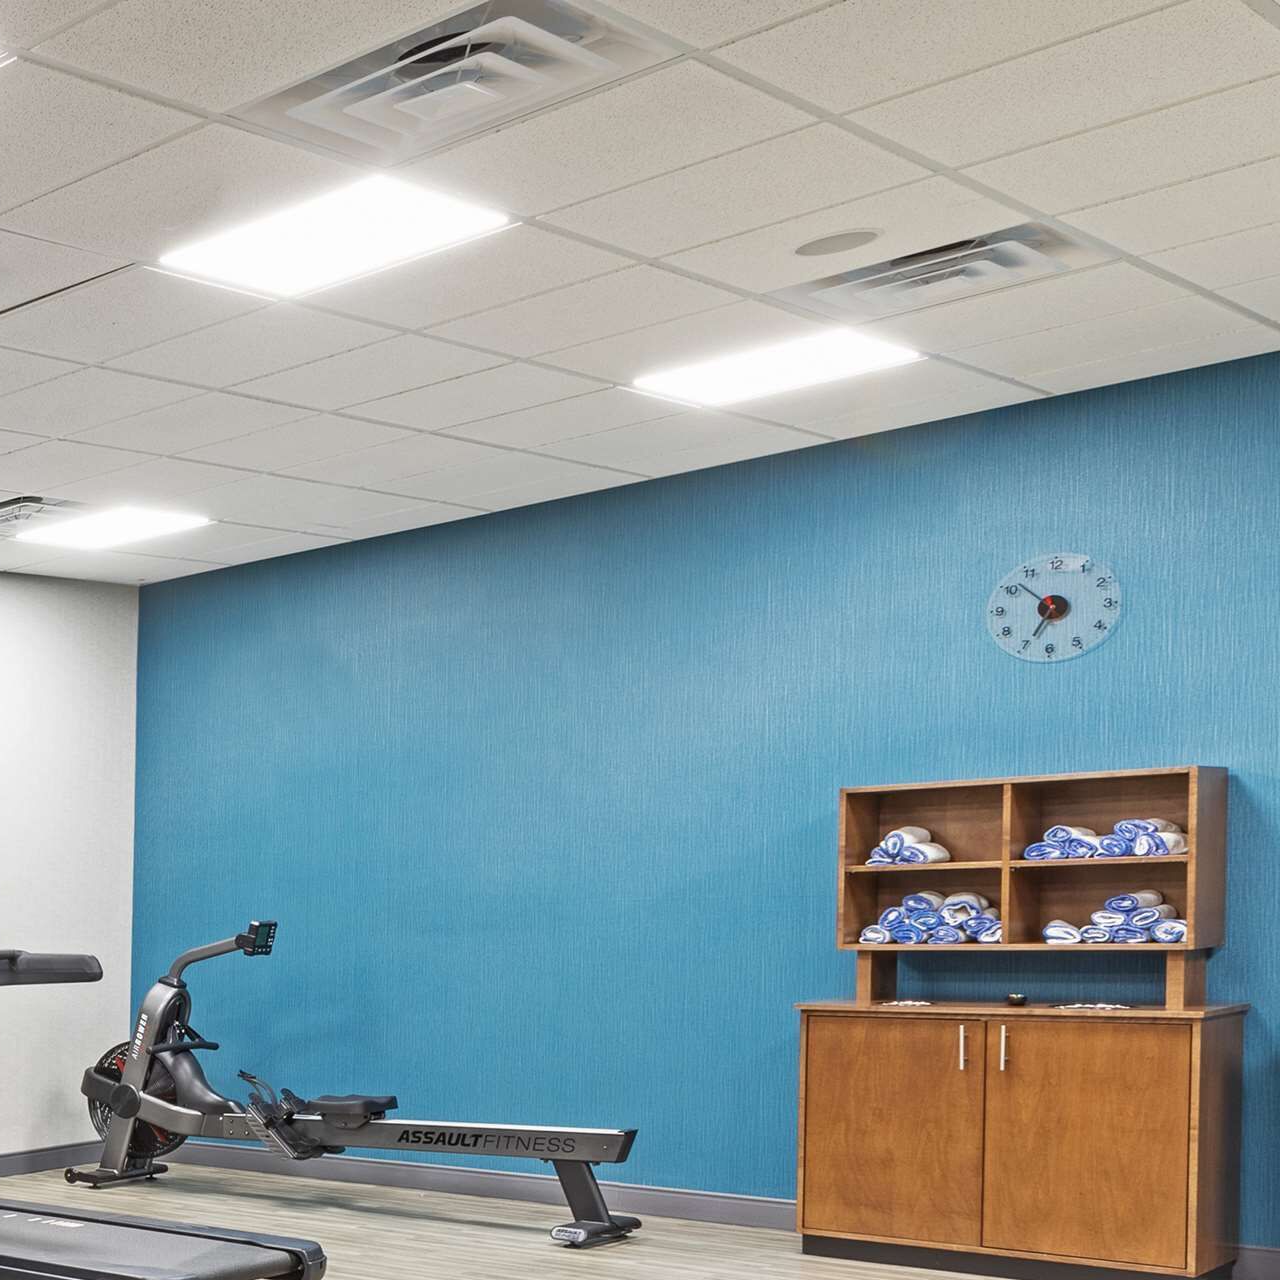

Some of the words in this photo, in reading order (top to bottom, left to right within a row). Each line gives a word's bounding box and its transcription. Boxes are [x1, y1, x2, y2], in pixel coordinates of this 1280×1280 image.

[1049, 560, 1063, 570] 12
[1024, 568, 1036, 578] 11
[1096, 577, 1106, 587] 2
[1005, 585, 1018, 595] 10
[1104, 598, 1113, 608] 3
[995, 606, 1005, 616] 9
[1093, 619, 1104, 630] 4
[1002, 626, 1011, 636] 8
[1072, 637, 1081, 647] 5
[1045, 643, 1054, 654] 6
